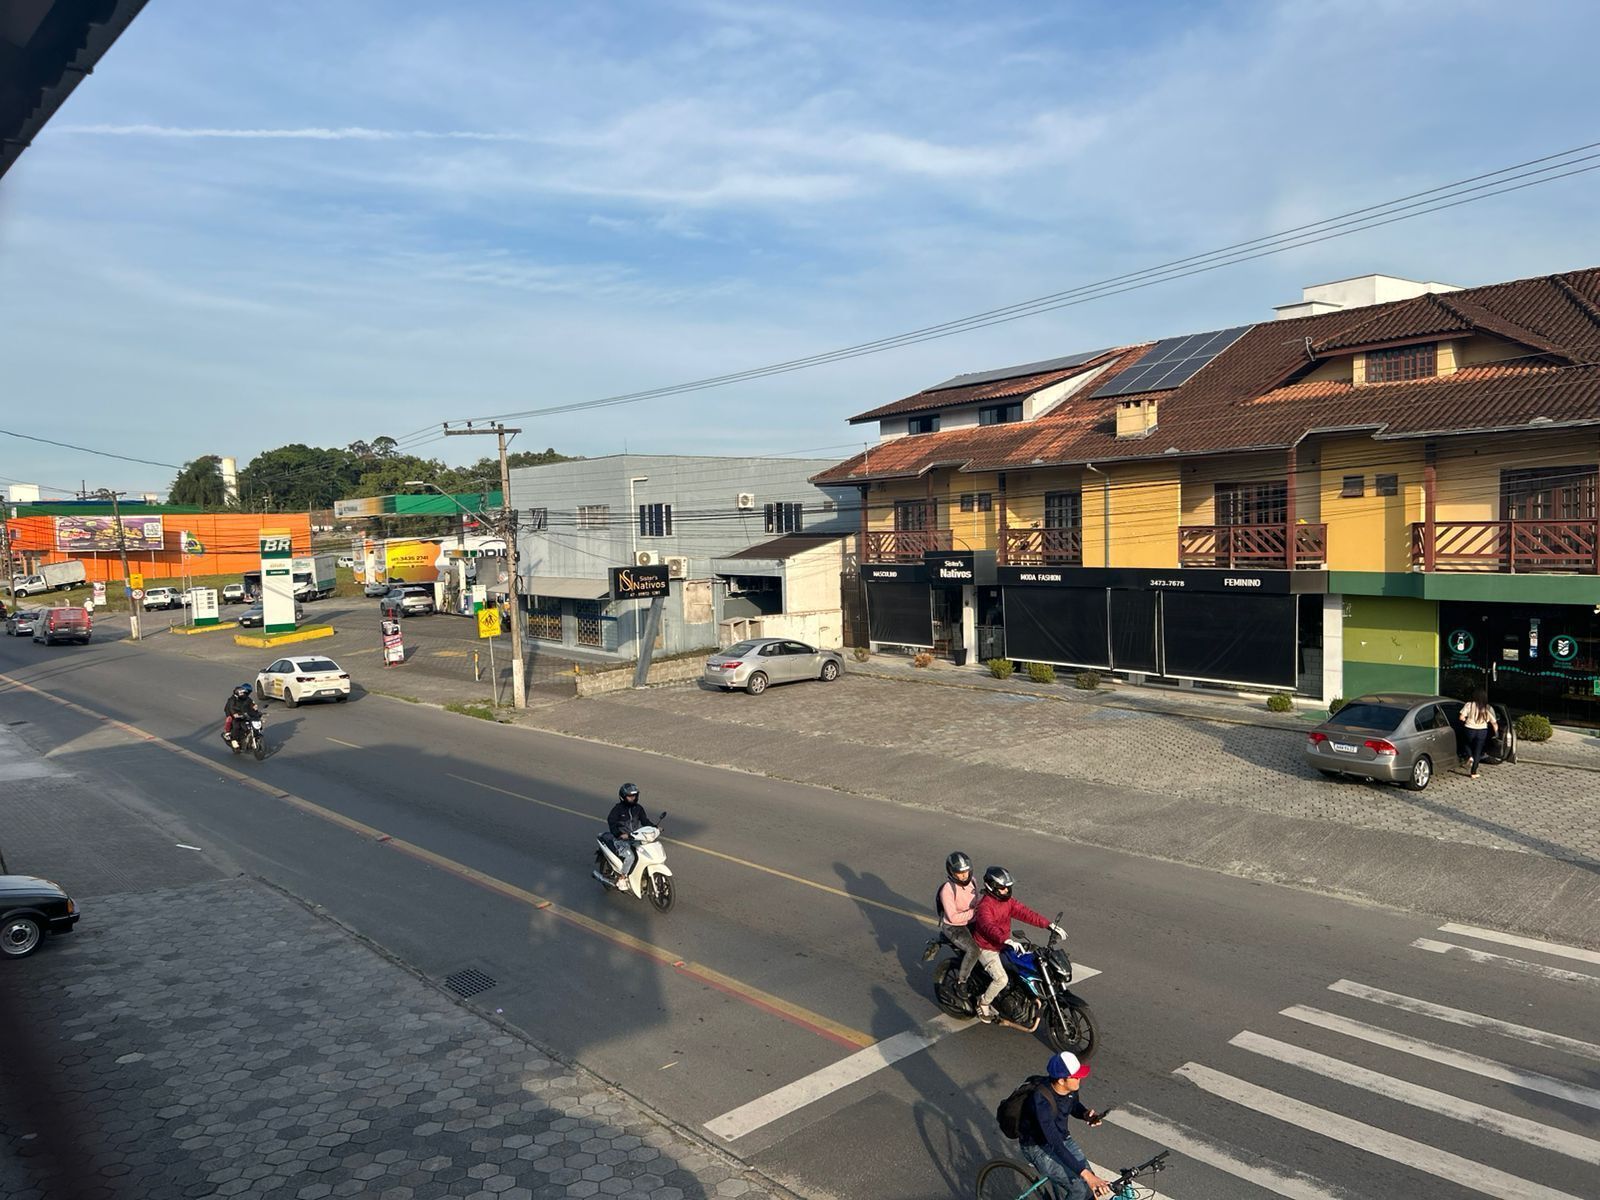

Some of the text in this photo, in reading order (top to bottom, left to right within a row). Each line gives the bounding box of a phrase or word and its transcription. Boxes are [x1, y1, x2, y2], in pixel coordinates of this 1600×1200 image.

[264, 538, 290, 551] BR
[940, 568, 972, 578] Nativos
[633, 581, 666, 590] Nativos
